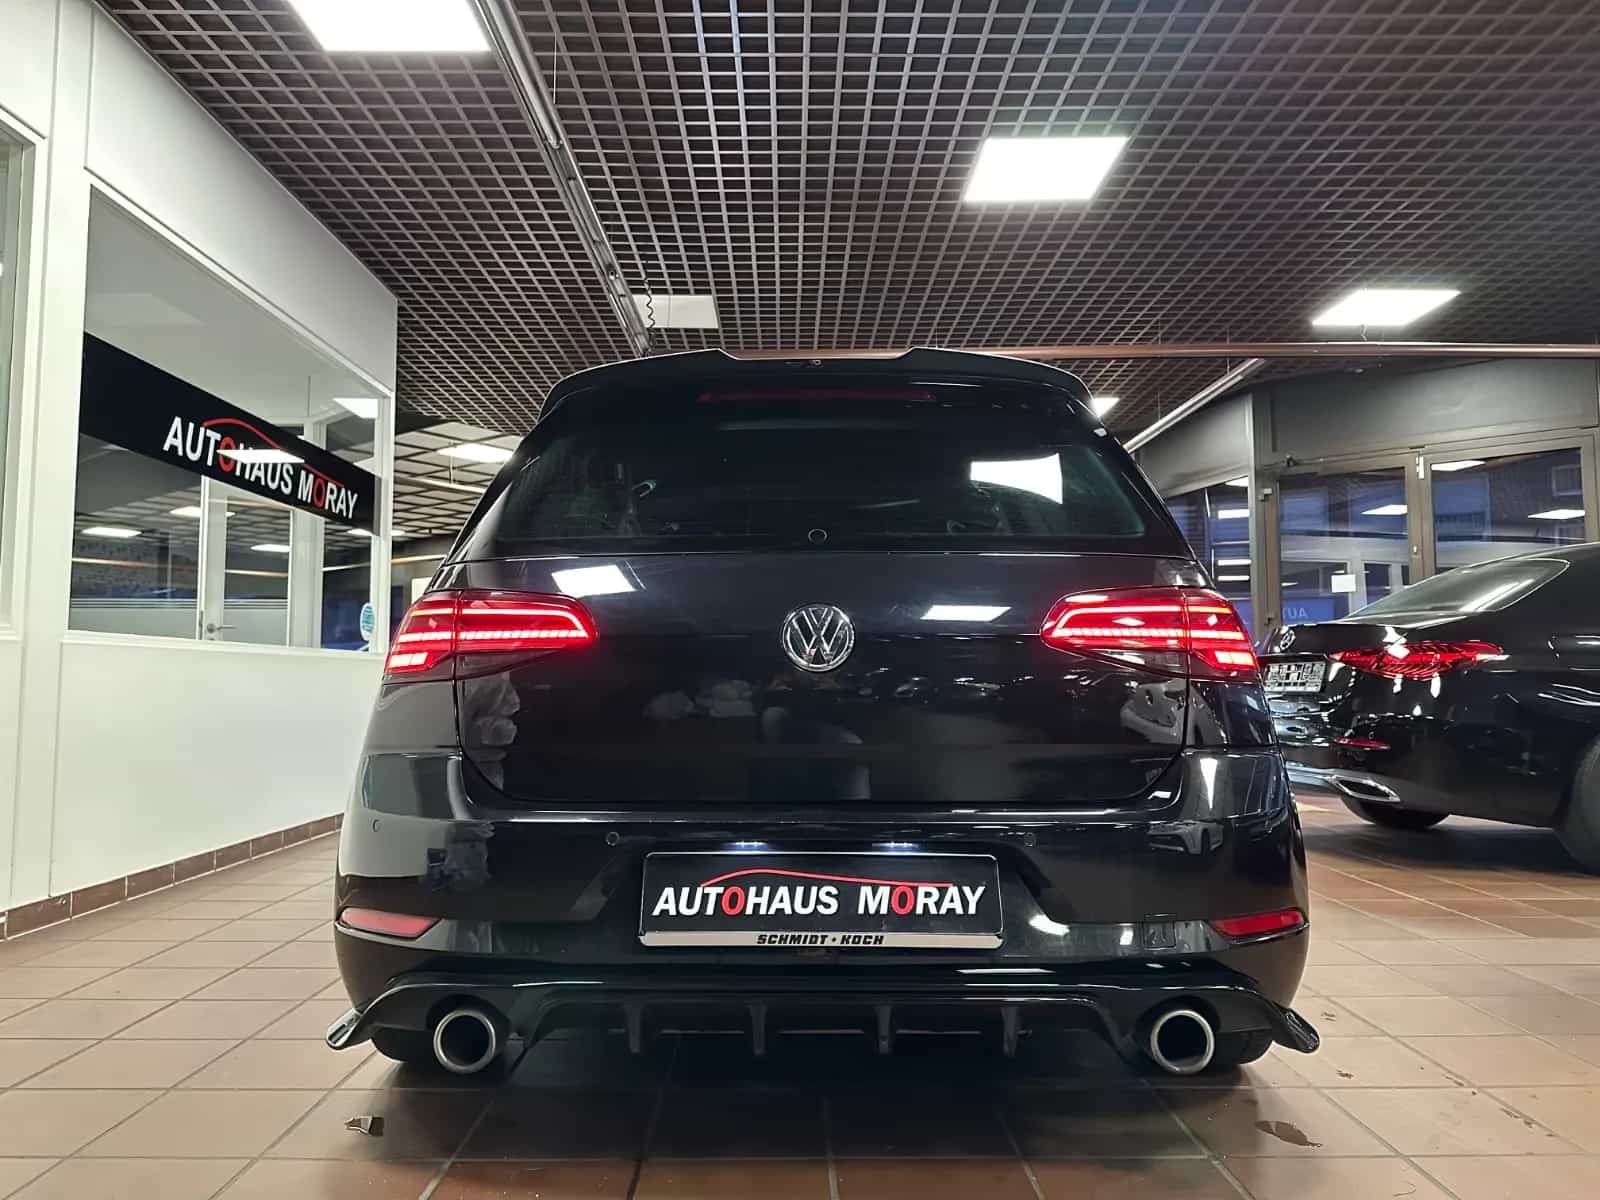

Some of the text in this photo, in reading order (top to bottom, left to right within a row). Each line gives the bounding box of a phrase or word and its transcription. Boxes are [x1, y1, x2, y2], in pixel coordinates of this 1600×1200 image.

[163, 416, 358, 519] AUTOHAUS MORAY
[653, 885, 985, 915] AUTOHAUS MORAY
[757, 934, 884, 945] SCHMIDT KOCH
